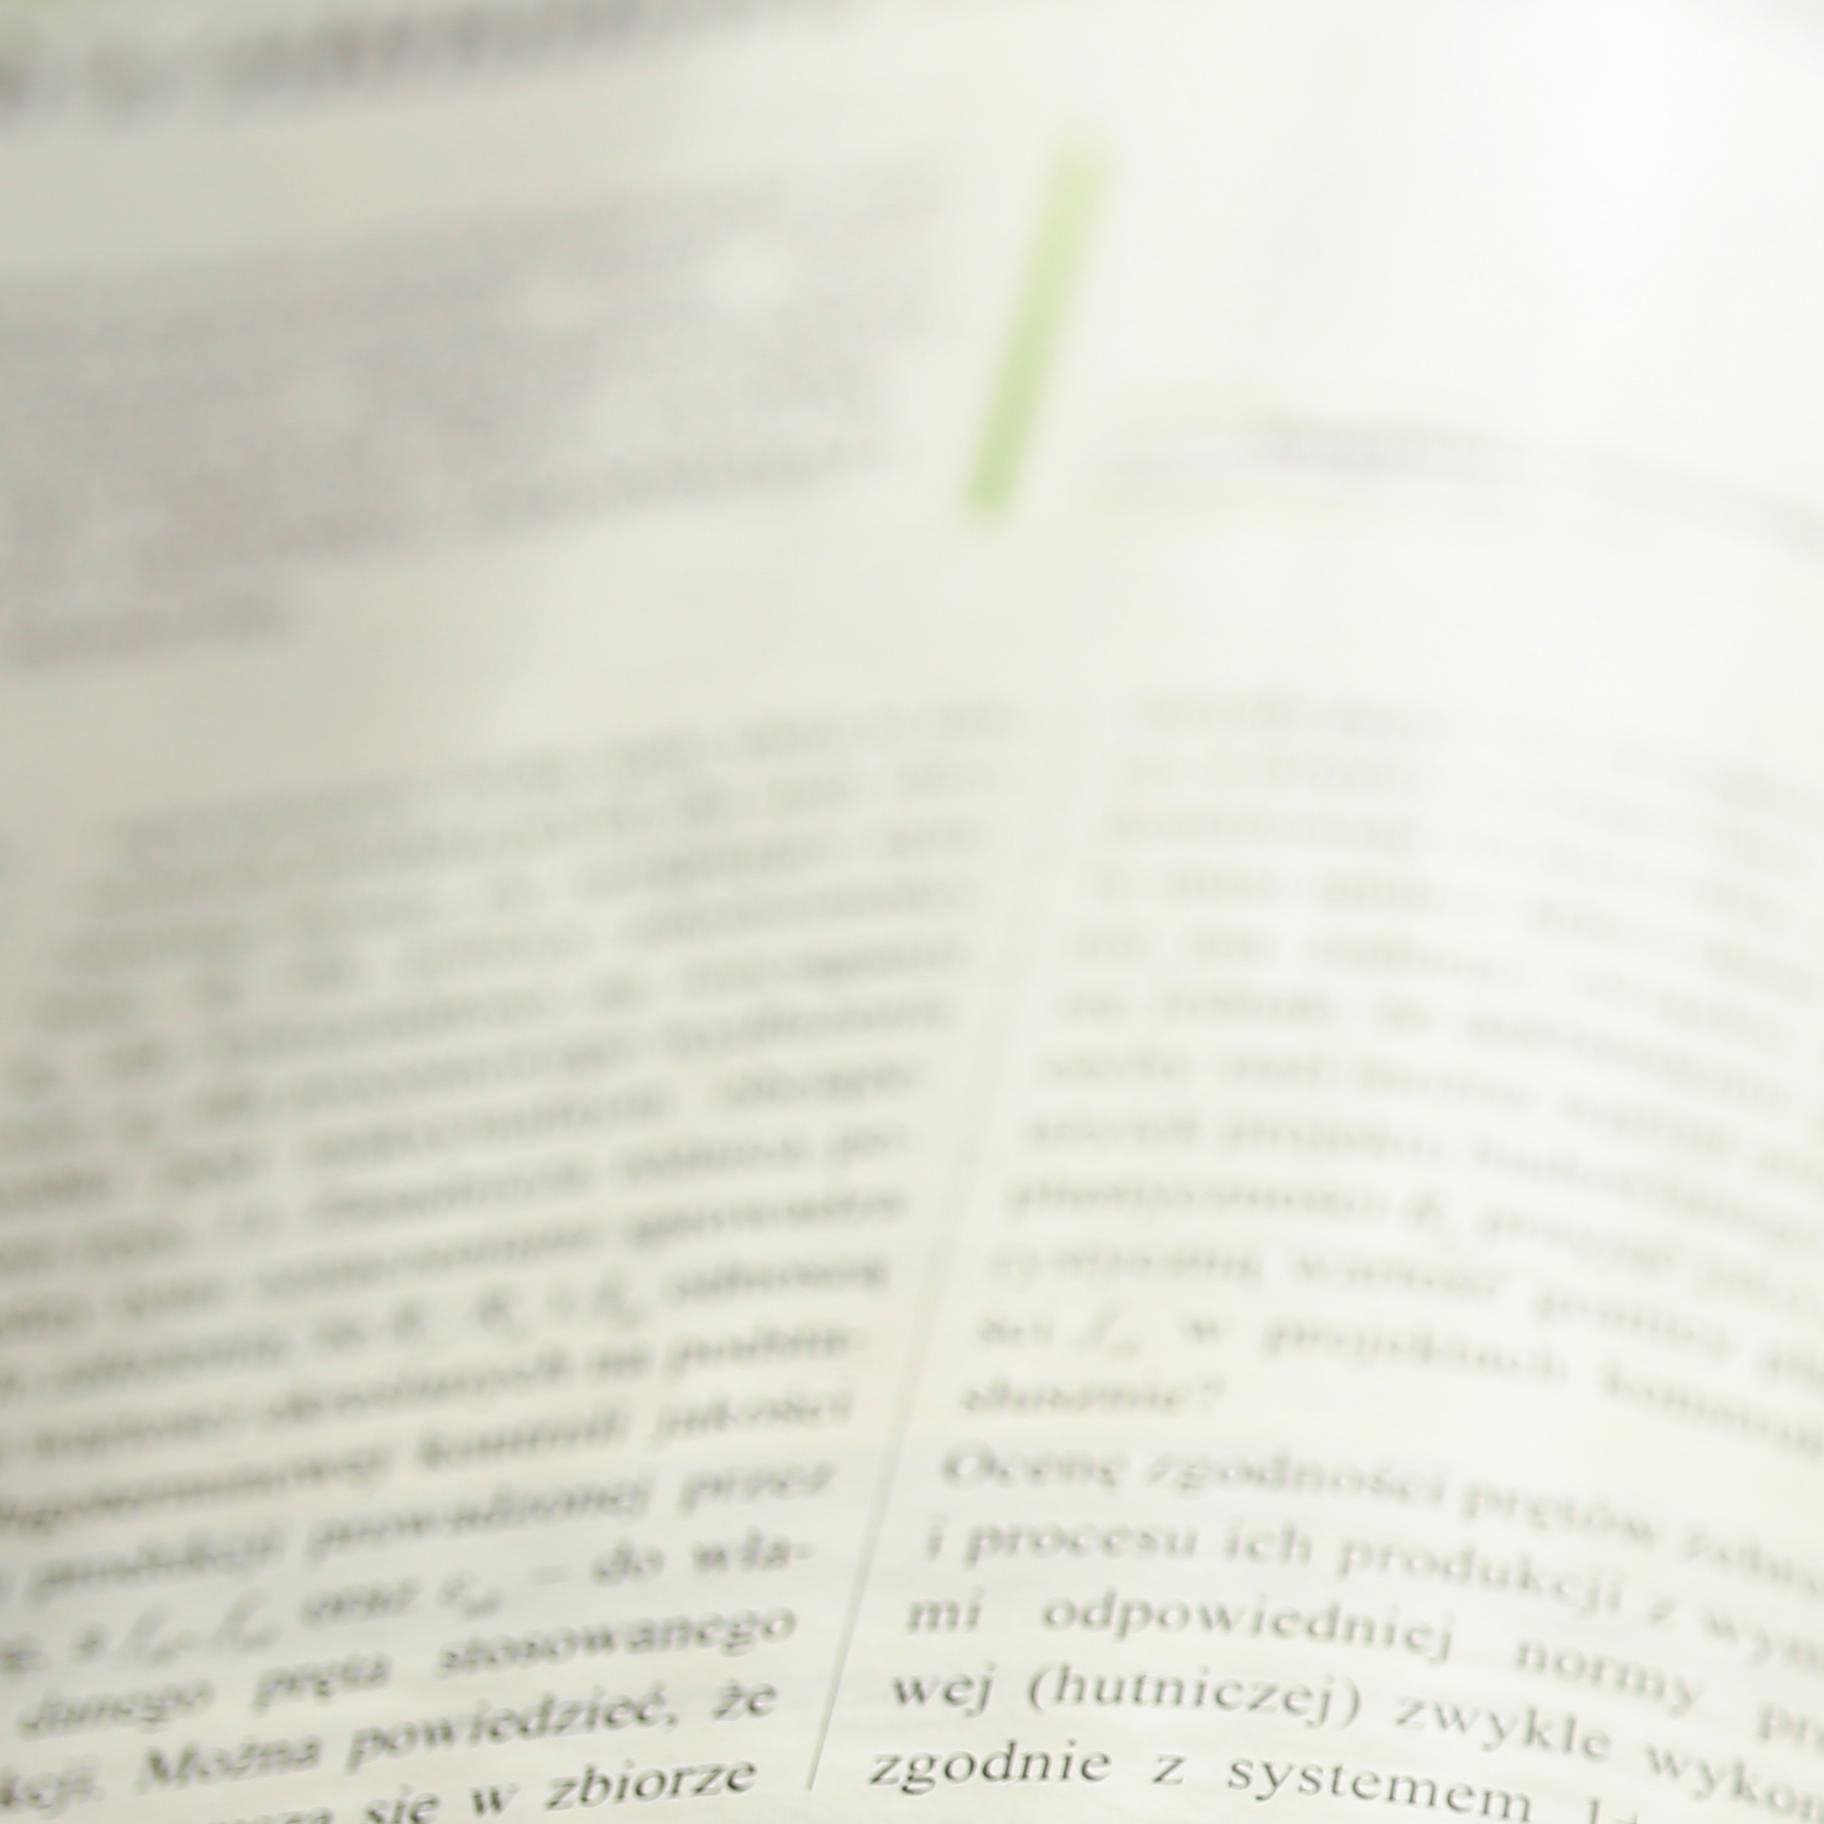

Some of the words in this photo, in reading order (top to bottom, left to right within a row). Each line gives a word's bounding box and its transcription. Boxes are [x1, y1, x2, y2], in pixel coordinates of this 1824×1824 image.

[941, 1439, 1126, 1493] Ocenę
[1145, 1444, 1447, 1510] zgodności
[925, 1514, 948, 1561] i
[964, 1523, 1196, 1570] procesu
[1222, 1519, 1313, 1568] ich
[1337, 1540, 1624, 1618] produkcji
[1649, 1598, 1677, 1626] z
[434, 1606, 798, 1678] stosowanego
[906, 1587, 983, 1636] mi
[1042, 1588, 1453, 1667] odpowiedniej
[1517, 1636, 1700, 1717] normy
[137, 1734, 322, 1794] Można
[347, 1680, 681, 1775] powiedzieć,
[711, 1678, 778, 1720] że
[891, 1659, 997, 1718] wej
[1028, 1662, 1363, 1732] (hutniczej)
[1395, 1699, 1613, 1764] zwykle
[472, 1781, 519, 1819] w
[547, 1757, 758, 1814] zbiorze
[868, 1739, 1112, 1796] zgodnie
[1152, 1753, 1187, 1786] z
[1227, 1755, 1533, 1824] systemem
